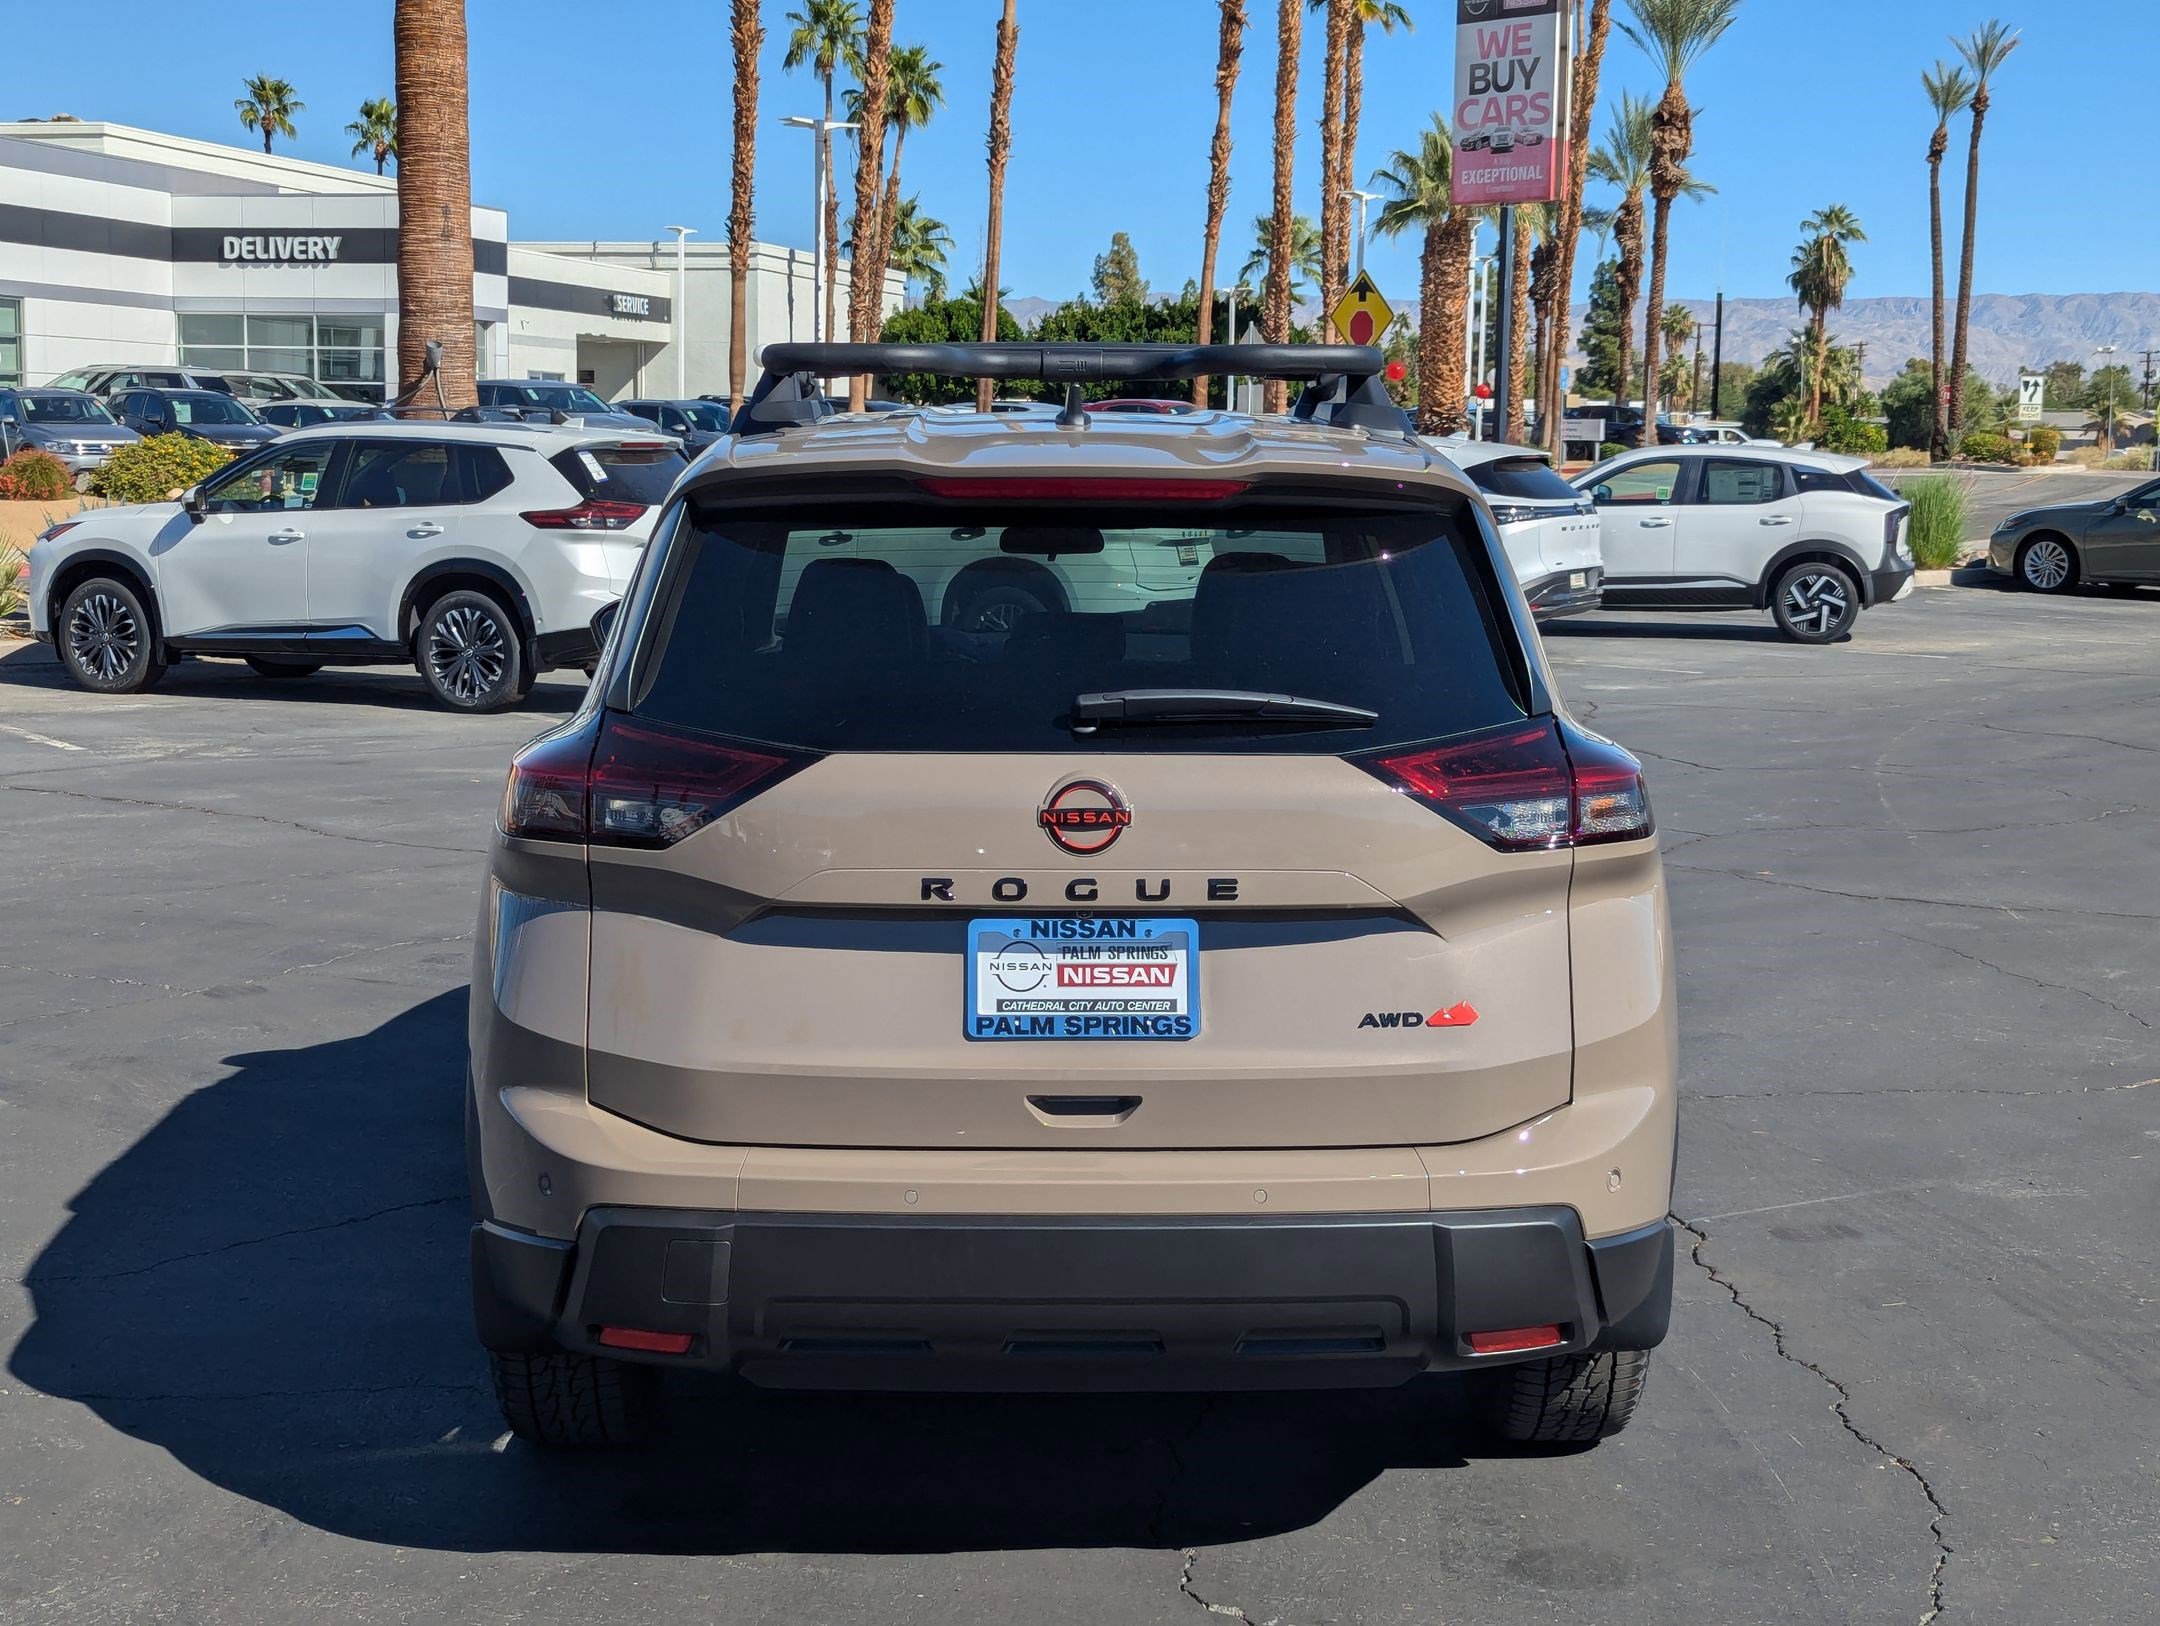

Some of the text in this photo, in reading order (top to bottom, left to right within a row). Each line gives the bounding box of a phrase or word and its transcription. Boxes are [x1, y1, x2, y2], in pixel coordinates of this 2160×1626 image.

[1476, 22, 1533, 60] WE
[1468, 56, 1541, 96] BUY
[1456, 91, 1551, 131] CARS
[1461, 165, 1543, 185] EXCEPTIONAL
[223, 235, 342, 260] DELIVERY
[613, 294, 649, 315] SERVICE
[1043, 812, 1129, 823] NISSAN
[921, 877, 1239, 901] ROGUE
[1030, 919, 1136, 939] NISSAN
[1061, 945, 1169, 961] PALM SPRINGS
[989, 962, 1053, 971] NISSAN
[1062, 967, 1171, 984] NISSAN
[1002, 1001, 1171, 1011] CATHEDRAL CITY AUTO CENTER
[975, 1015, 1192, 1035] PALM SPRINGS
[1357, 1012, 1424, 1029] AWD
